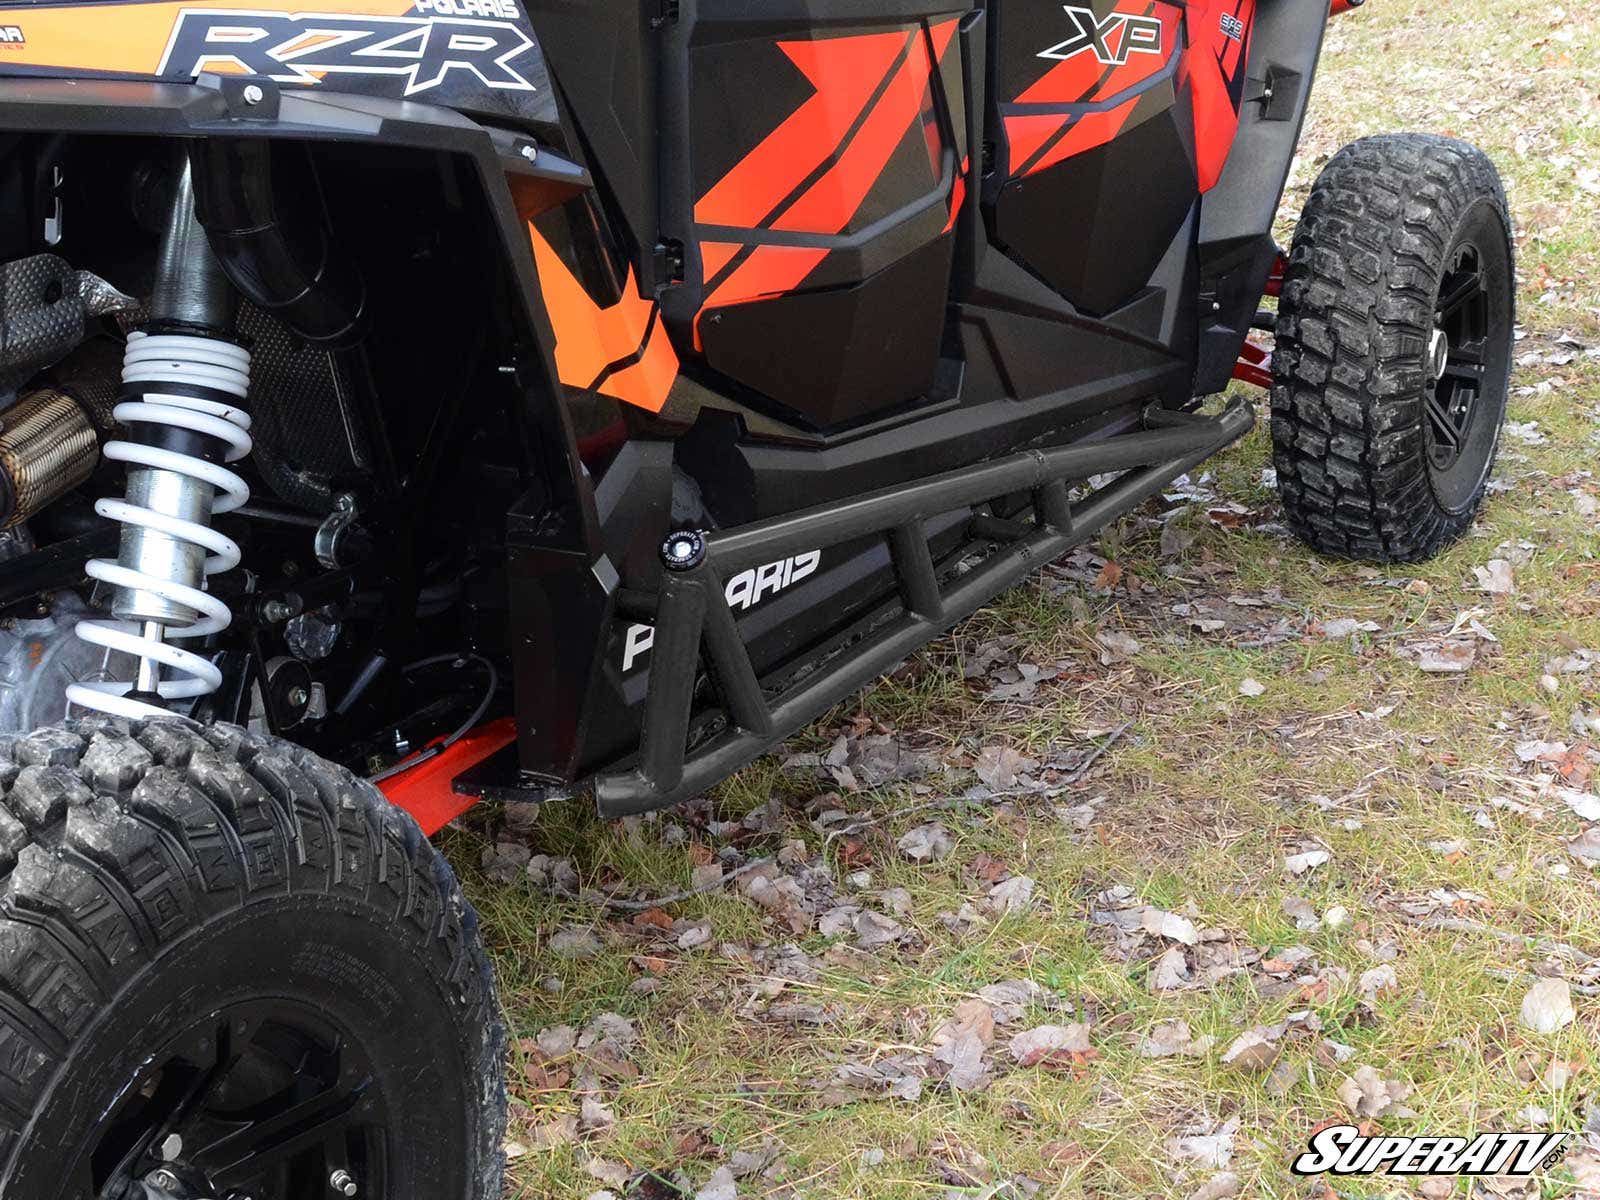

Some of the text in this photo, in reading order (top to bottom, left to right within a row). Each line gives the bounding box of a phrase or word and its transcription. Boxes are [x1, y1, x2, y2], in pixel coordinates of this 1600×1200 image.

[414, 0, 520, 18] POLARIS
[1036, 5, 1162, 65] XP
[155, 8, 536, 95] RZR
[622, 549, 821, 672] PARIS
